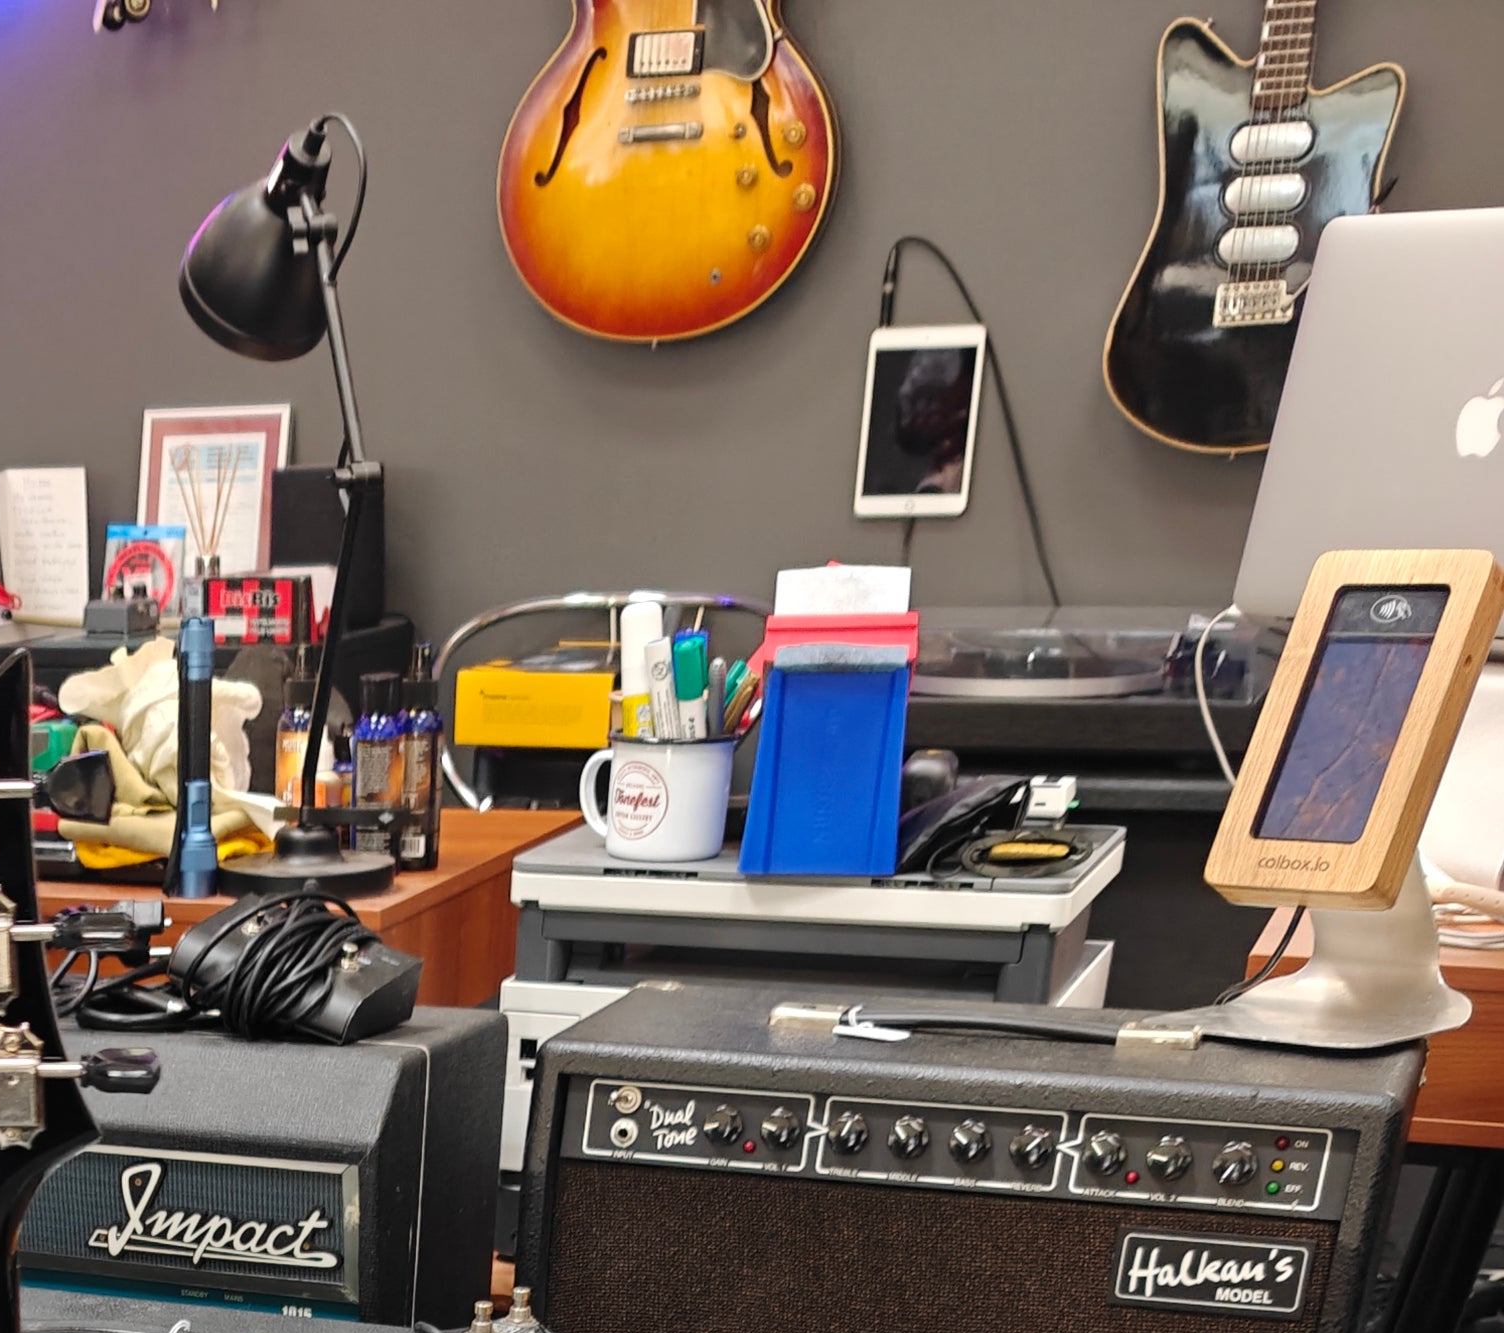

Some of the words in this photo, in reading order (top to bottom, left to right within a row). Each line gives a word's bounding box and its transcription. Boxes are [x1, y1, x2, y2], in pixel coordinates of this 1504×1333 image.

[1258, 854, 1330, 872] colbox.io
[653, 1127, 698, 1150] Tone
[1294, 1139, 1309, 1149] ON
[888, 1171, 918, 1182] MIDDLE
[1083, 1187, 1116, 1199] ATTACK
[89, 1163, 337, 1268] Impact
[1128, 1246, 1295, 1298] Halkan's
[1215, 1287, 1274, 1305] MODEL
